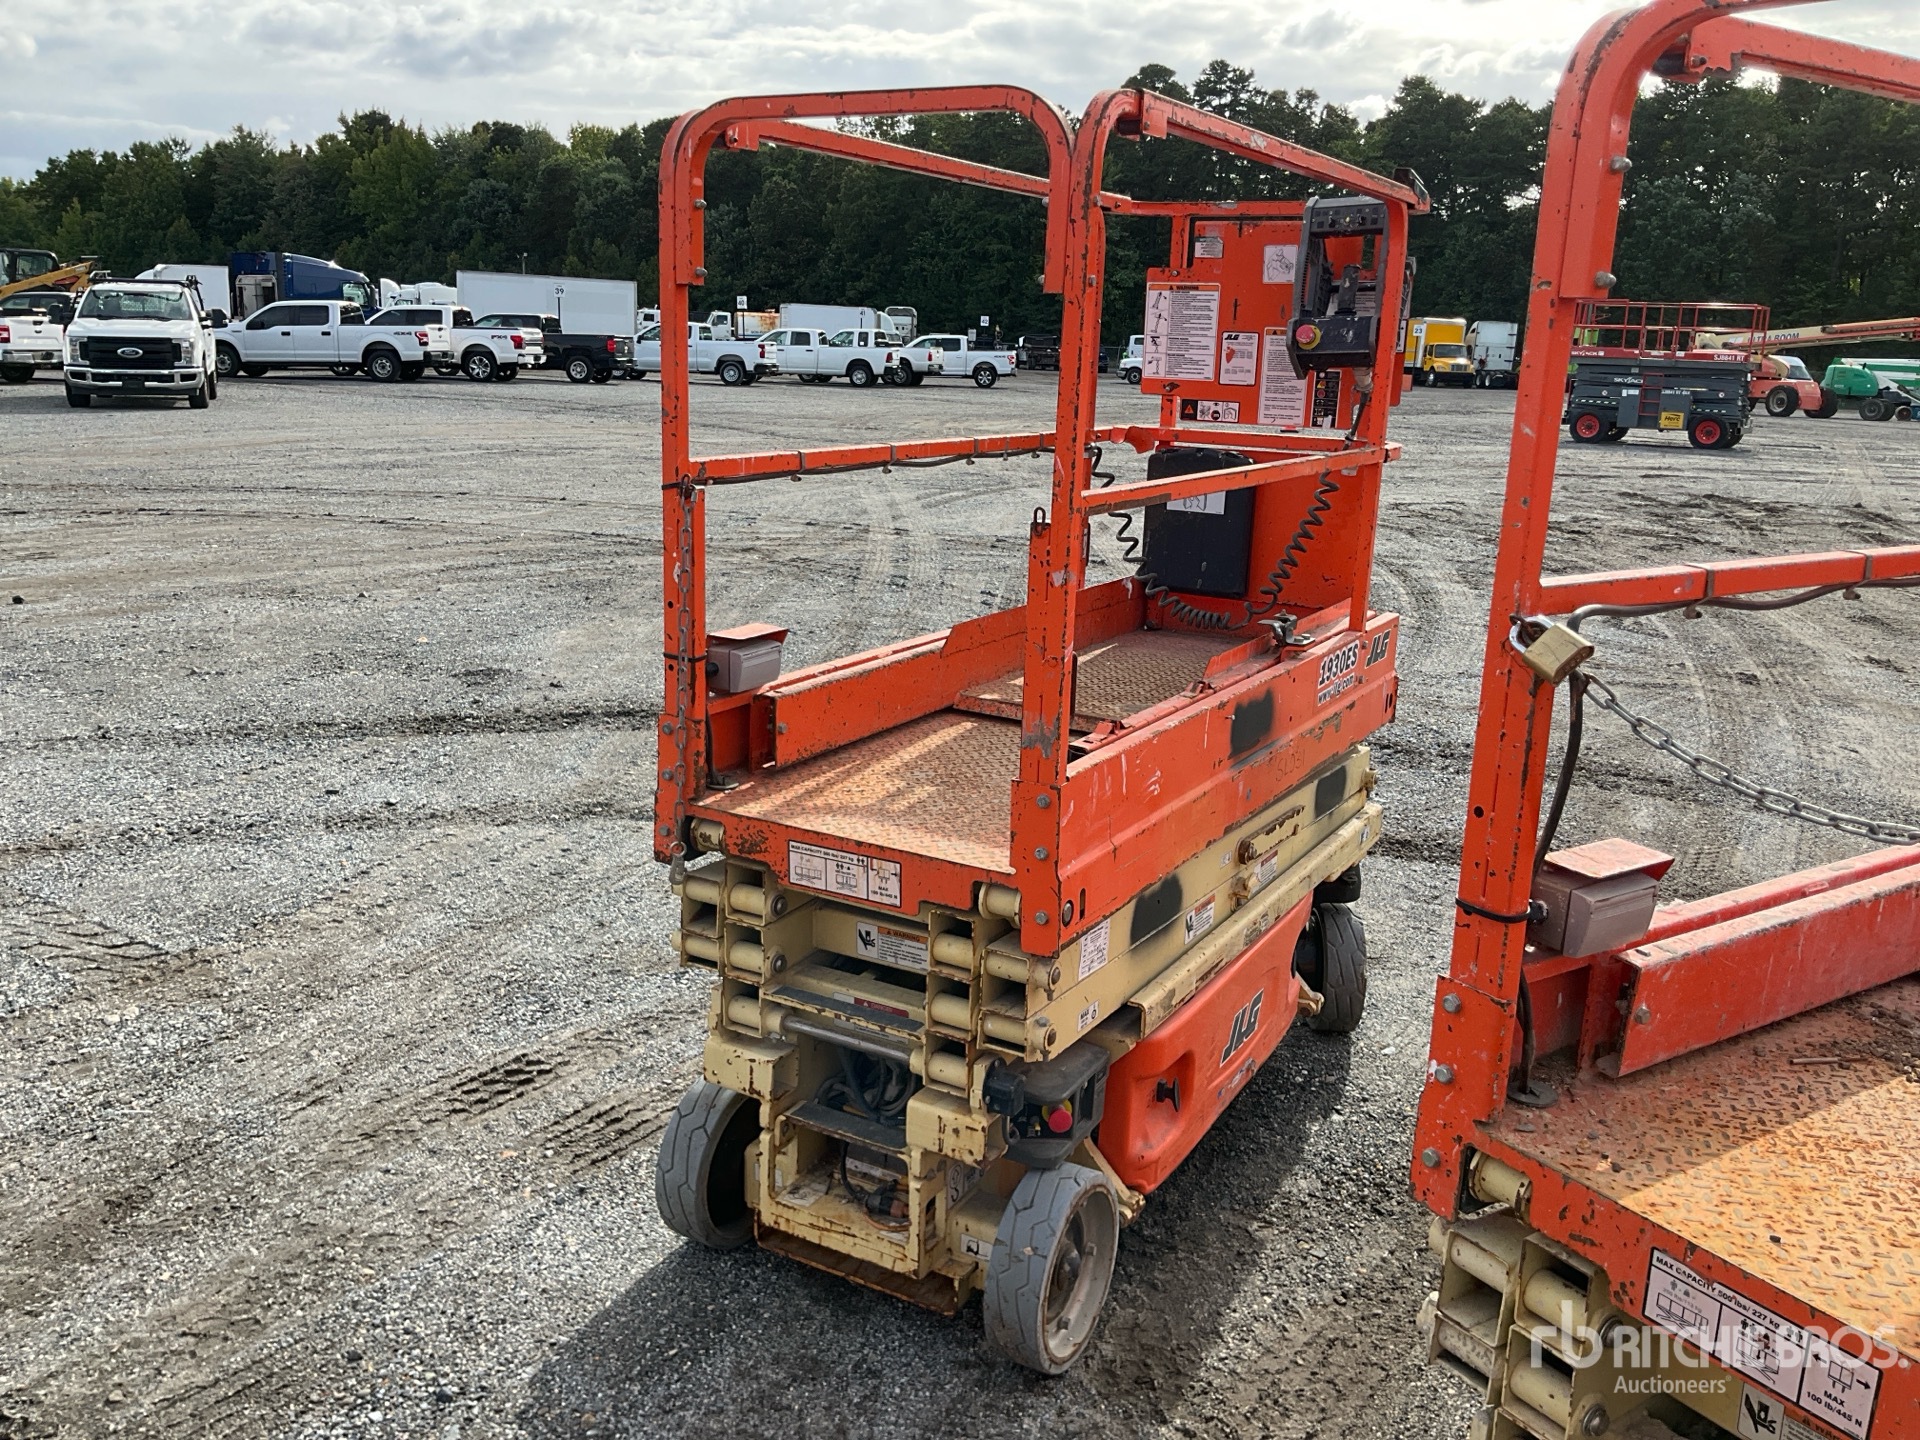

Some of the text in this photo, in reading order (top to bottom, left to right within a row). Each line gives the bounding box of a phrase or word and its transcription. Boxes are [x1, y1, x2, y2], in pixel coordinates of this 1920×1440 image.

[554, 287, 565, 295] 39
[1774, 332, 1800, 341] BOOM
[1319, 629, 1392, 687] 1930ES JLG
[1220, 988, 1265, 1067] JLG
[1655, 1255, 1675, 1271] MAX
[1675, 1266, 1717, 1293] CAPACITY
[1717, 1289, 1733, 1303] 500
[1751, 1308, 1768, 1321] 227
[1768, 1317, 1781, 1330] kg
[1807, 1391, 1863, 1428] 100 lb/445 N
[1823, 1390, 1845, 1408] MAX
